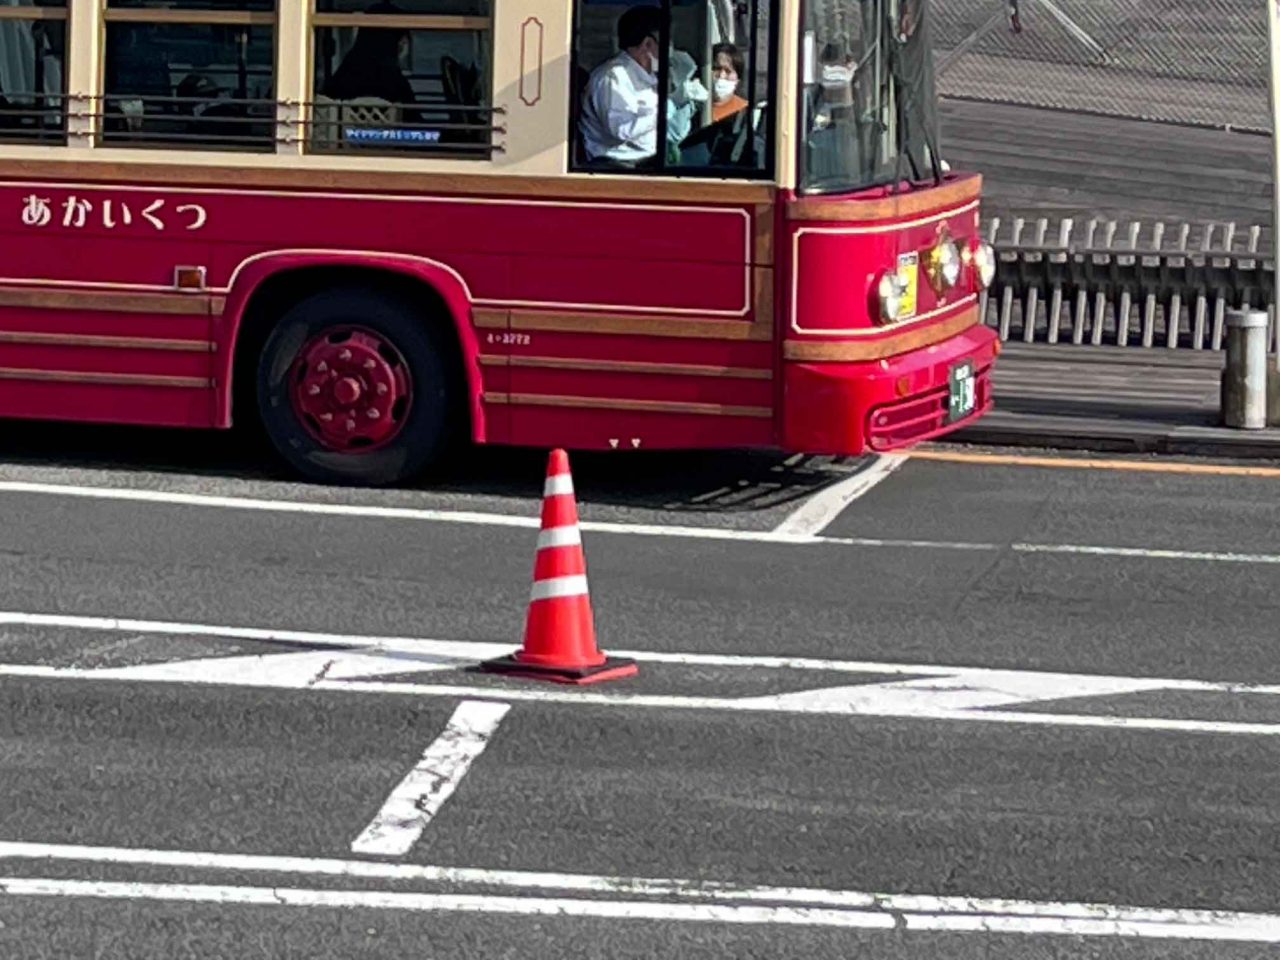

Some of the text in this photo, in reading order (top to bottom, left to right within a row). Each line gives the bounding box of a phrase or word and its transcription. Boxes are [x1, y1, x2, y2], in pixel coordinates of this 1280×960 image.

[22, 194, 207, 230] あかいくつ
